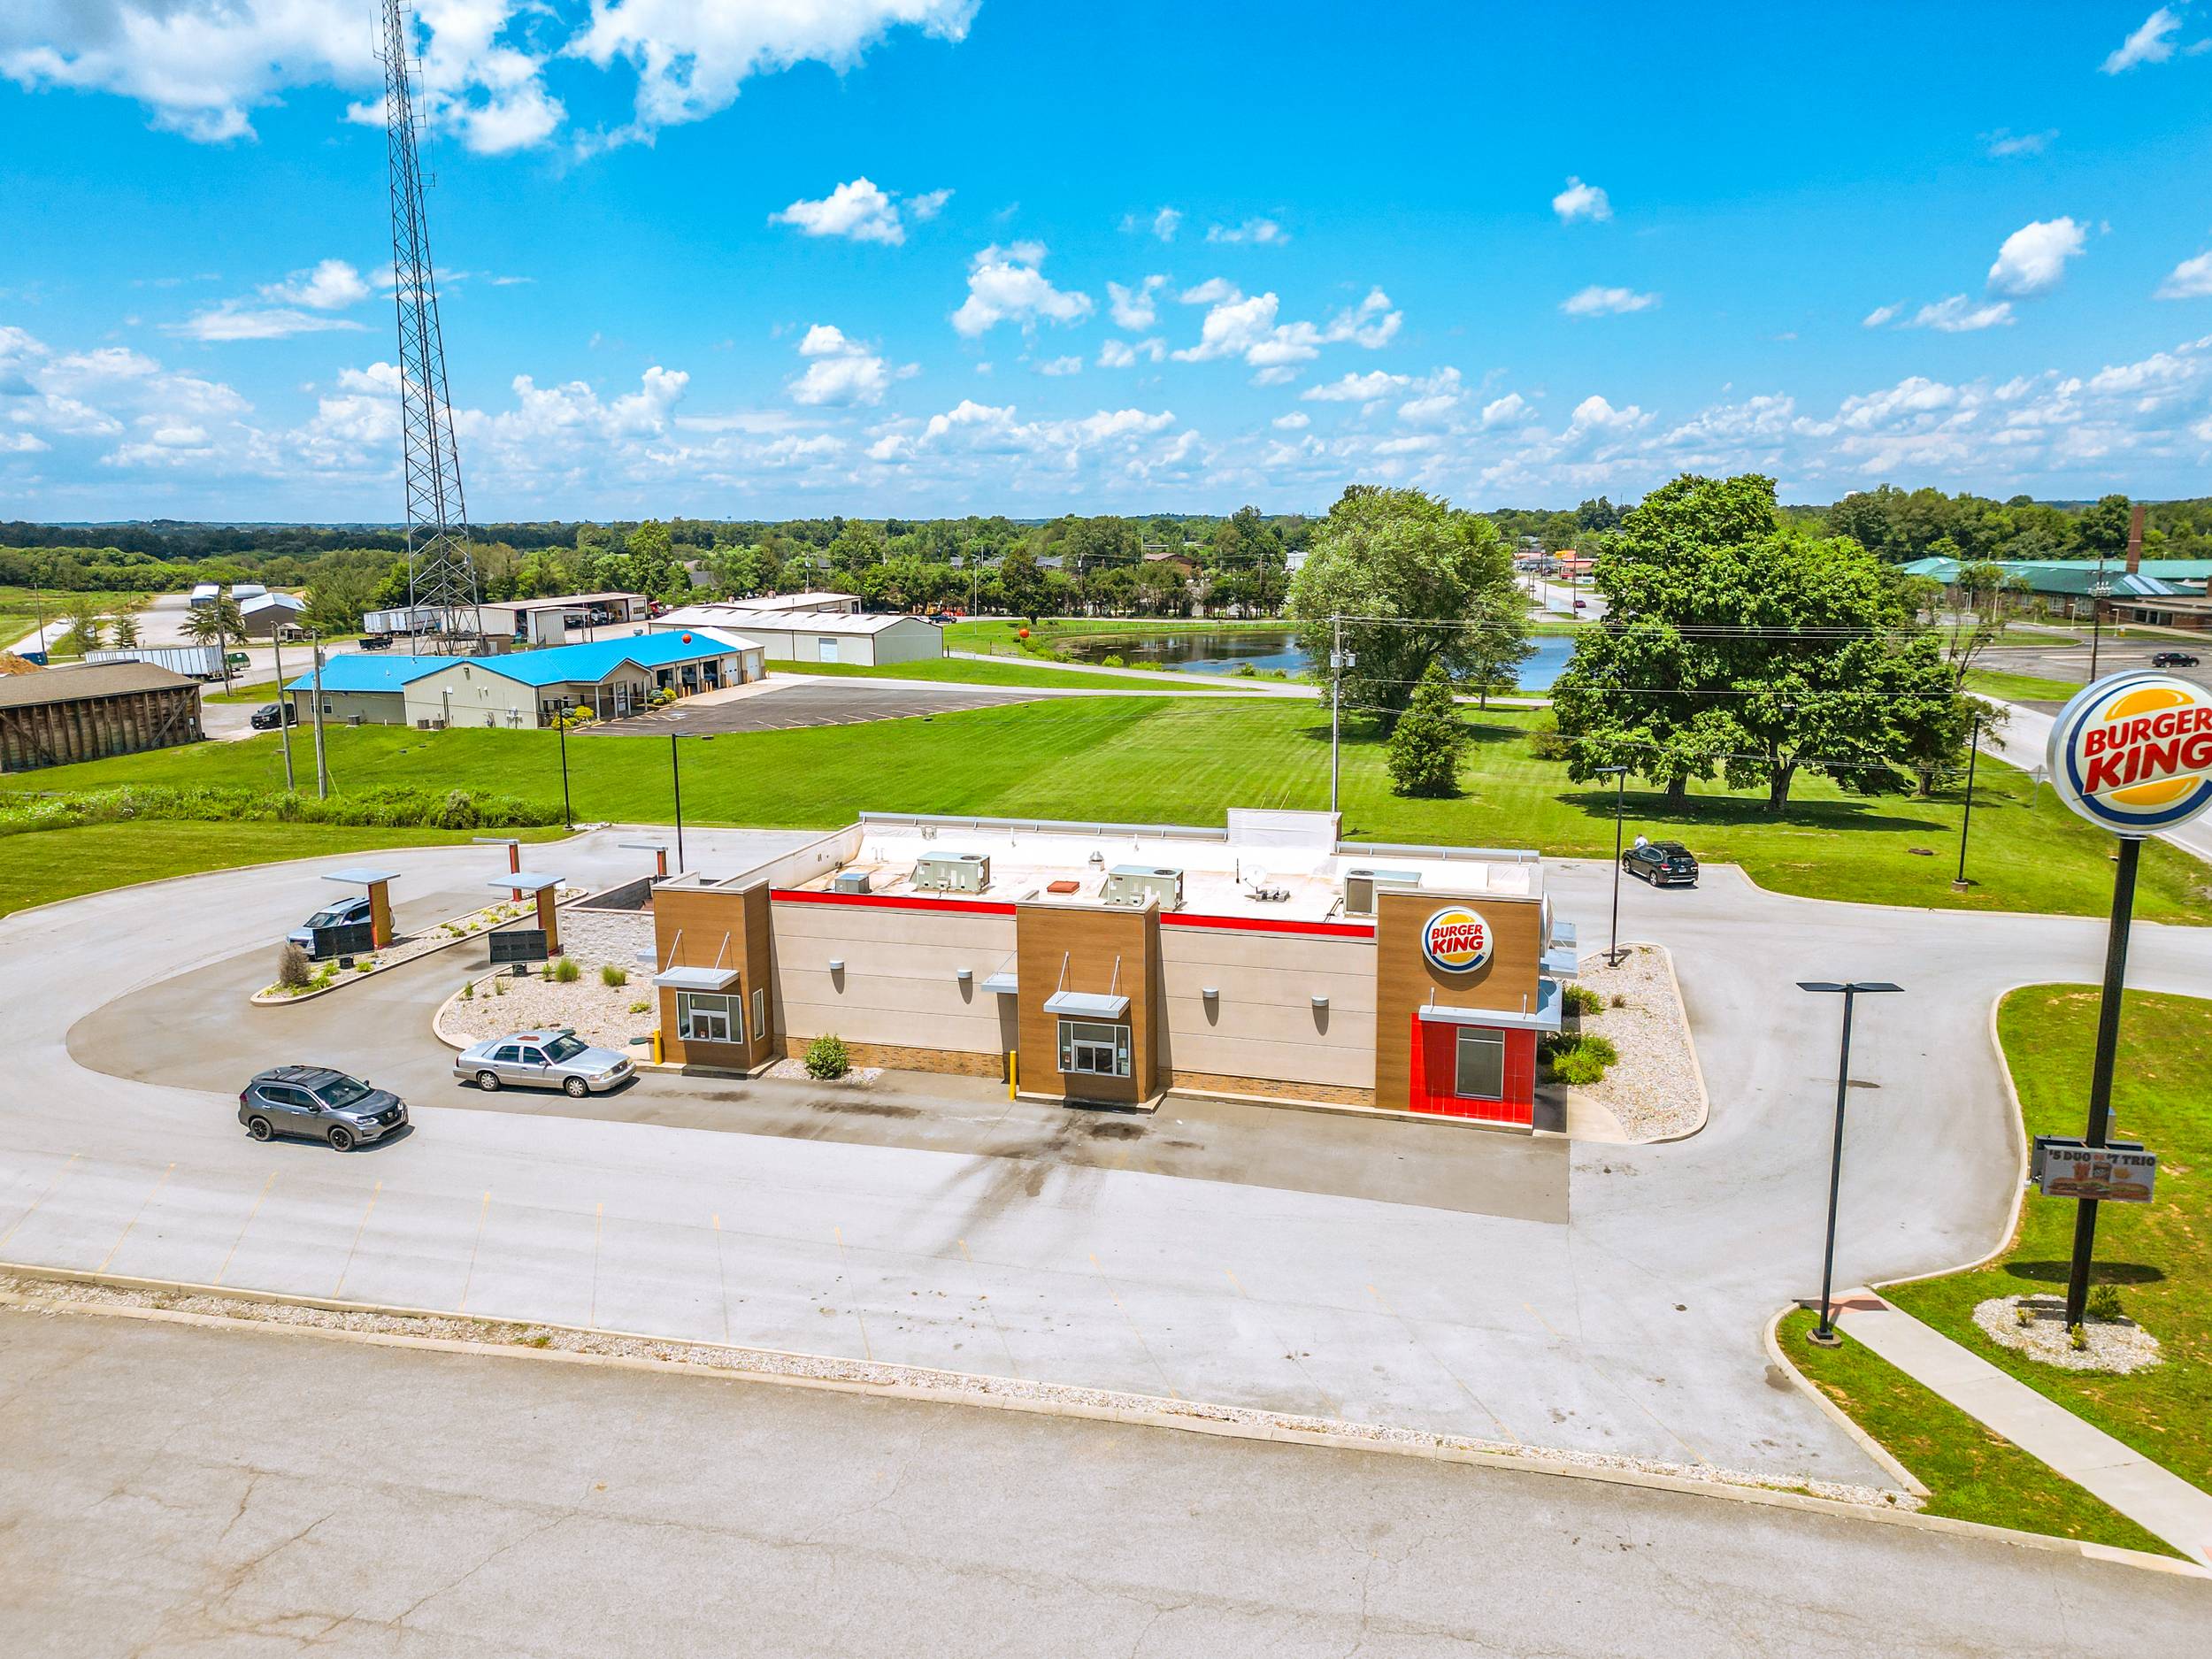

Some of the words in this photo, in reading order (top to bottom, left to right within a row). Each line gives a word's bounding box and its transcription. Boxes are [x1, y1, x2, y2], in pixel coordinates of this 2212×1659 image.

[2084, 707, 2212, 758] BURGER
[2083, 733, 2212, 795] KING
[1432, 925, 1483, 940] BURGER
[1432, 935, 1484, 955] KING
[2063, 1151, 2091, 1162] DUO
[2122, 1156, 2155, 1166] TRIO
